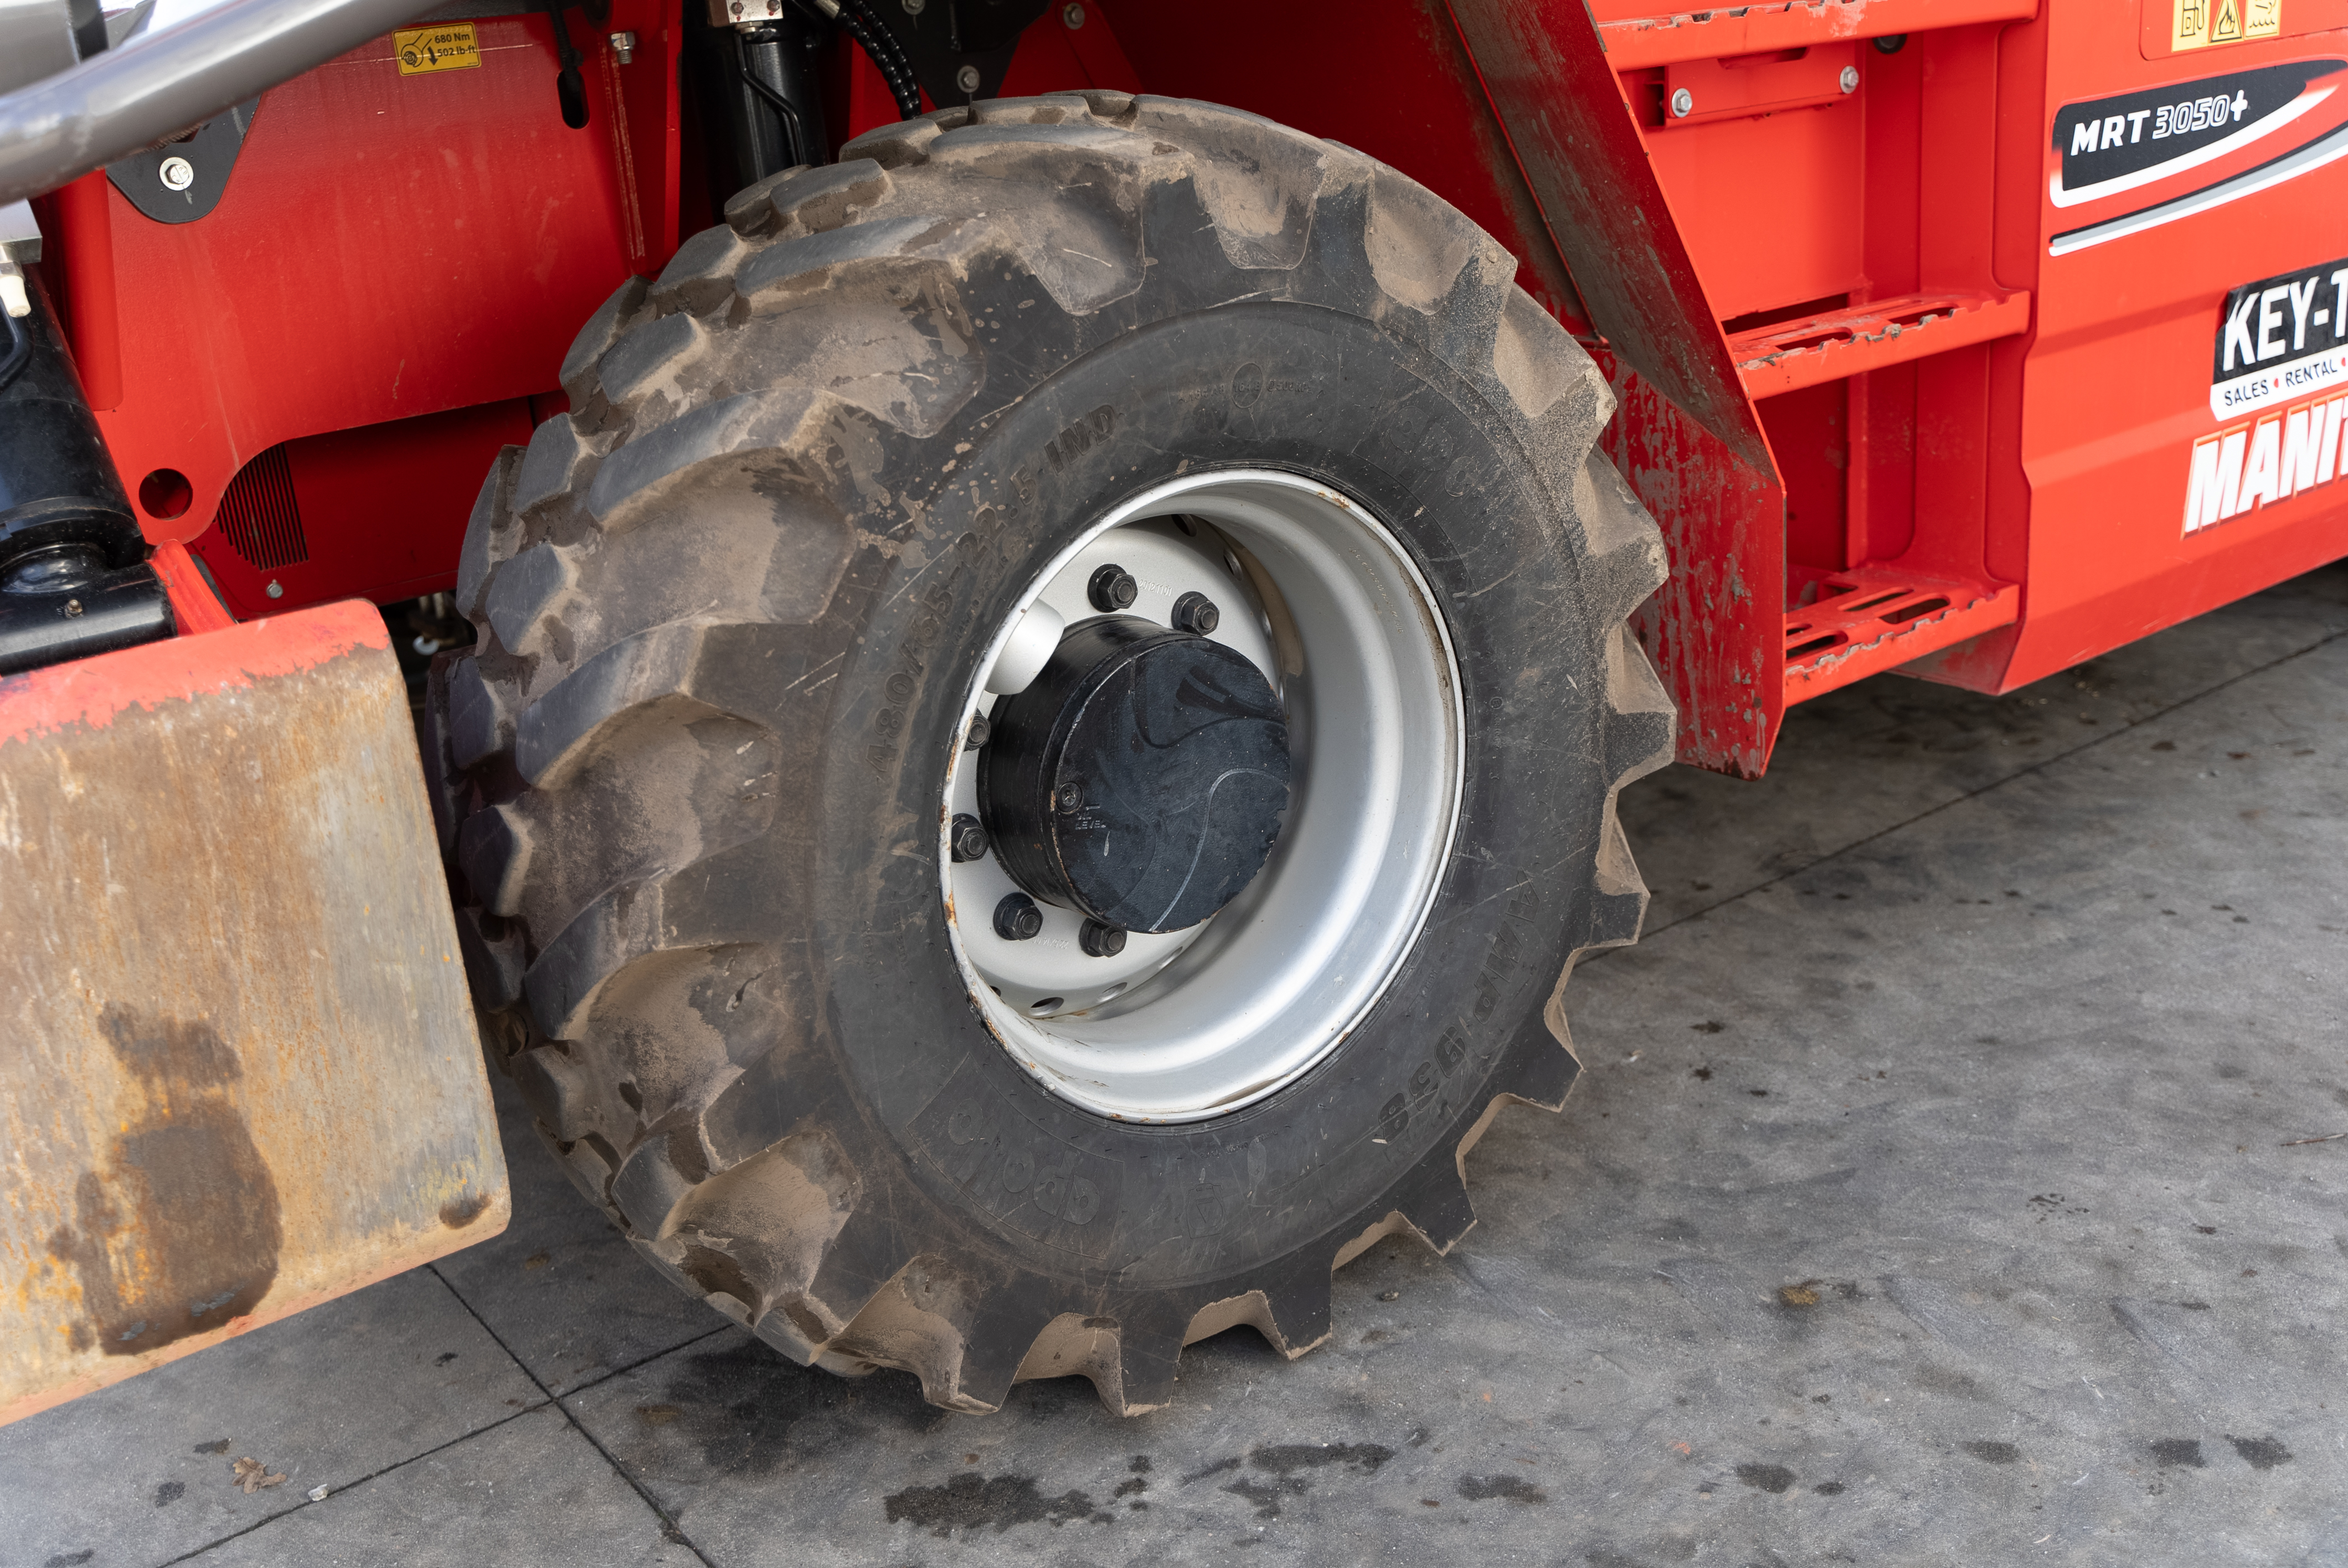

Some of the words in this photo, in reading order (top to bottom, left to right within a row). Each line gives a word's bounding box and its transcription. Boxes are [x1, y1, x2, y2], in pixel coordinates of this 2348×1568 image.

[435, 34, 452, 44] 680
[454, 33, 470, 42] Nm
[437, 48, 455, 57] 502
[2070, 109, 2151, 157] MRT
[2152, 90, 2248, 140] 3050+
[2224, 379, 2269, 407] SALES
[2285, 360, 2338, 388] RENTAL
[1043, 403, 1118, 476] IND
[1139, 579, 1172, 597] 20121101
[1378, 1026, 1467, 1144] 938
[948, 1097, 1101, 1226] apollo
